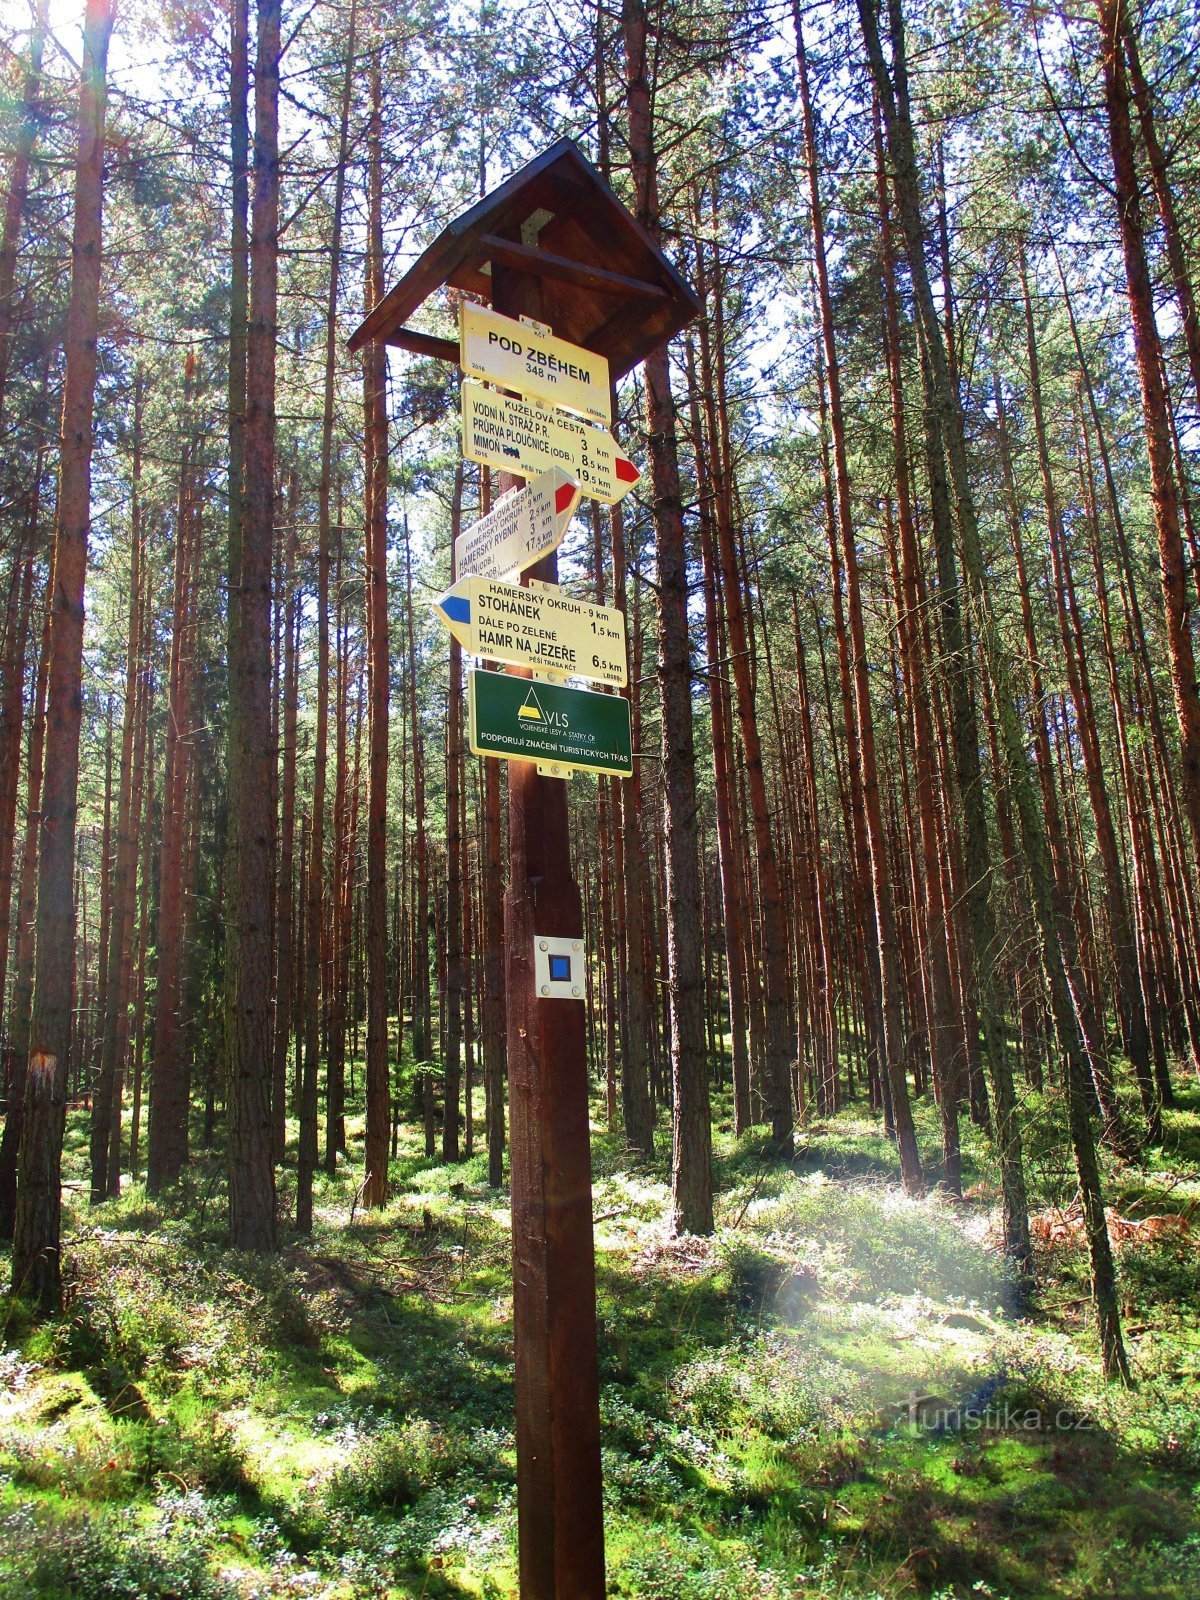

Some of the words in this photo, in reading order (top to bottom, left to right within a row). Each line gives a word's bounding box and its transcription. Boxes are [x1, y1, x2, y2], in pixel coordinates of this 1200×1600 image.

[472, 363, 486, 372] 2016
[488, 331, 522, 356] POD
[527, 347, 590, 384] ZBĚHEM
[526, 363, 544, 378] 348
[548, 373, 557, 383] m
[473, 401, 498, 420] VODNÍ
[500, 410, 508, 424] N.
[509, 413, 534, 432] STRÁŽ
[581, 440, 588, 450] 3
[596, 448, 610, 458] km
[505, 400, 554, 424] KUŽELOVÁ
[557, 419, 586, 436] CESTA
[473, 417, 504, 438] PRŮRVA
[506, 428, 550, 454] PLOUČNICE
[550, 448, 574, 463] (ODB.)
[582, 455, 595, 468] 8,5
[597, 462, 610, 474] km
[474, 450, 488, 458] 2016
[474, 434, 500, 454] MIMOŇ
[576, 468, 596, 484] 19,5
[598, 478, 611, 489] km
[500, 506, 522, 528] OKRUH
[528, 499, 532, 508] 9
[533, 492, 542, 503] km
[512, 488, 532, 508] CESTA
[460, 537, 494, 570] HAMERSKÝ
[495, 520, 518, 546] RYBNÍK
[541, 502, 550, 514] km
[530, 523, 535, 534] 3
[542, 516, 552, 528] km
[526, 536, 540, 552] 17,5
[542, 530, 552, 541] km
[478, 594, 540, 620] STOHÁNEK
[590, 622, 605, 636] 1,5
[607, 626, 620, 639] km
[490, 584, 544, 605] HAMERSKÝ
[548, 599, 580, 614] OKRUH
[588, 608, 594, 618] 9
[596, 610, 609, 622] km
[478, 615, 504, 630] DÁLE
[506, 620, 520, 632] PO
[522, 626, 557, 642] ZELENÉ
[479, 630, 512, 649] HAMR
[516, 638, 532, 652] NA
[534, 642, 576, 662] JEZEŘE
[592, 655, 606, 670] 6,5
[609, 660, 622, 672] km
[480, 646, 494, 654] 2016
[544, 660, 564, 670] TRASA
[564, 663, 576, 672] KČT
[519, 723, 548, 734] VOJENSKÉ
[568, 732, 586, 740] STATKY
[546, 710, 568, 728] VLS
[481, 732, 524, 746] PODPORUJÍ
[526, 738, 558, 752] ZNAČENÍ
[559, 744, 608, 760] TURISTICKÝCH
[610, 754, 628, 763] TRAS
